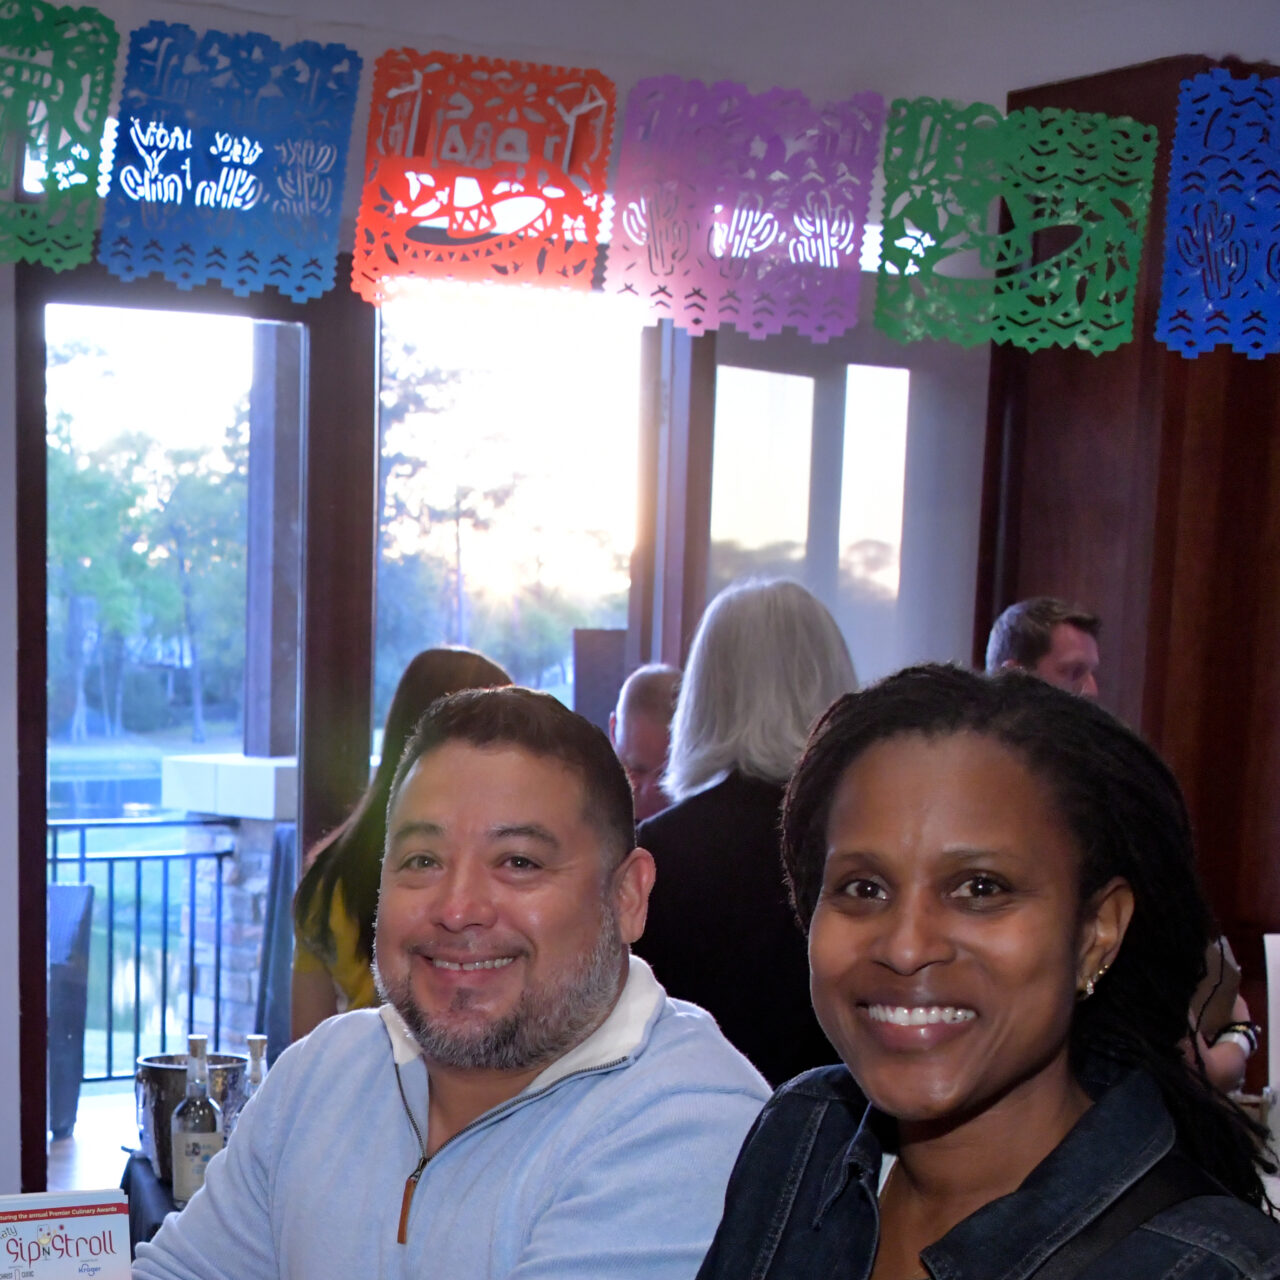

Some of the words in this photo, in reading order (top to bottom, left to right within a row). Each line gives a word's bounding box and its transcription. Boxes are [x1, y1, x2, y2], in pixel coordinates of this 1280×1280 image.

[28, 1210, 48, 1219] annual
[49, 1209, 71, 1217] Premier
[72, 1207, 96, 1215] Culinary
[42, 1246, 51, 1256] N
[78, 1263, 102, 1277] Kroger
